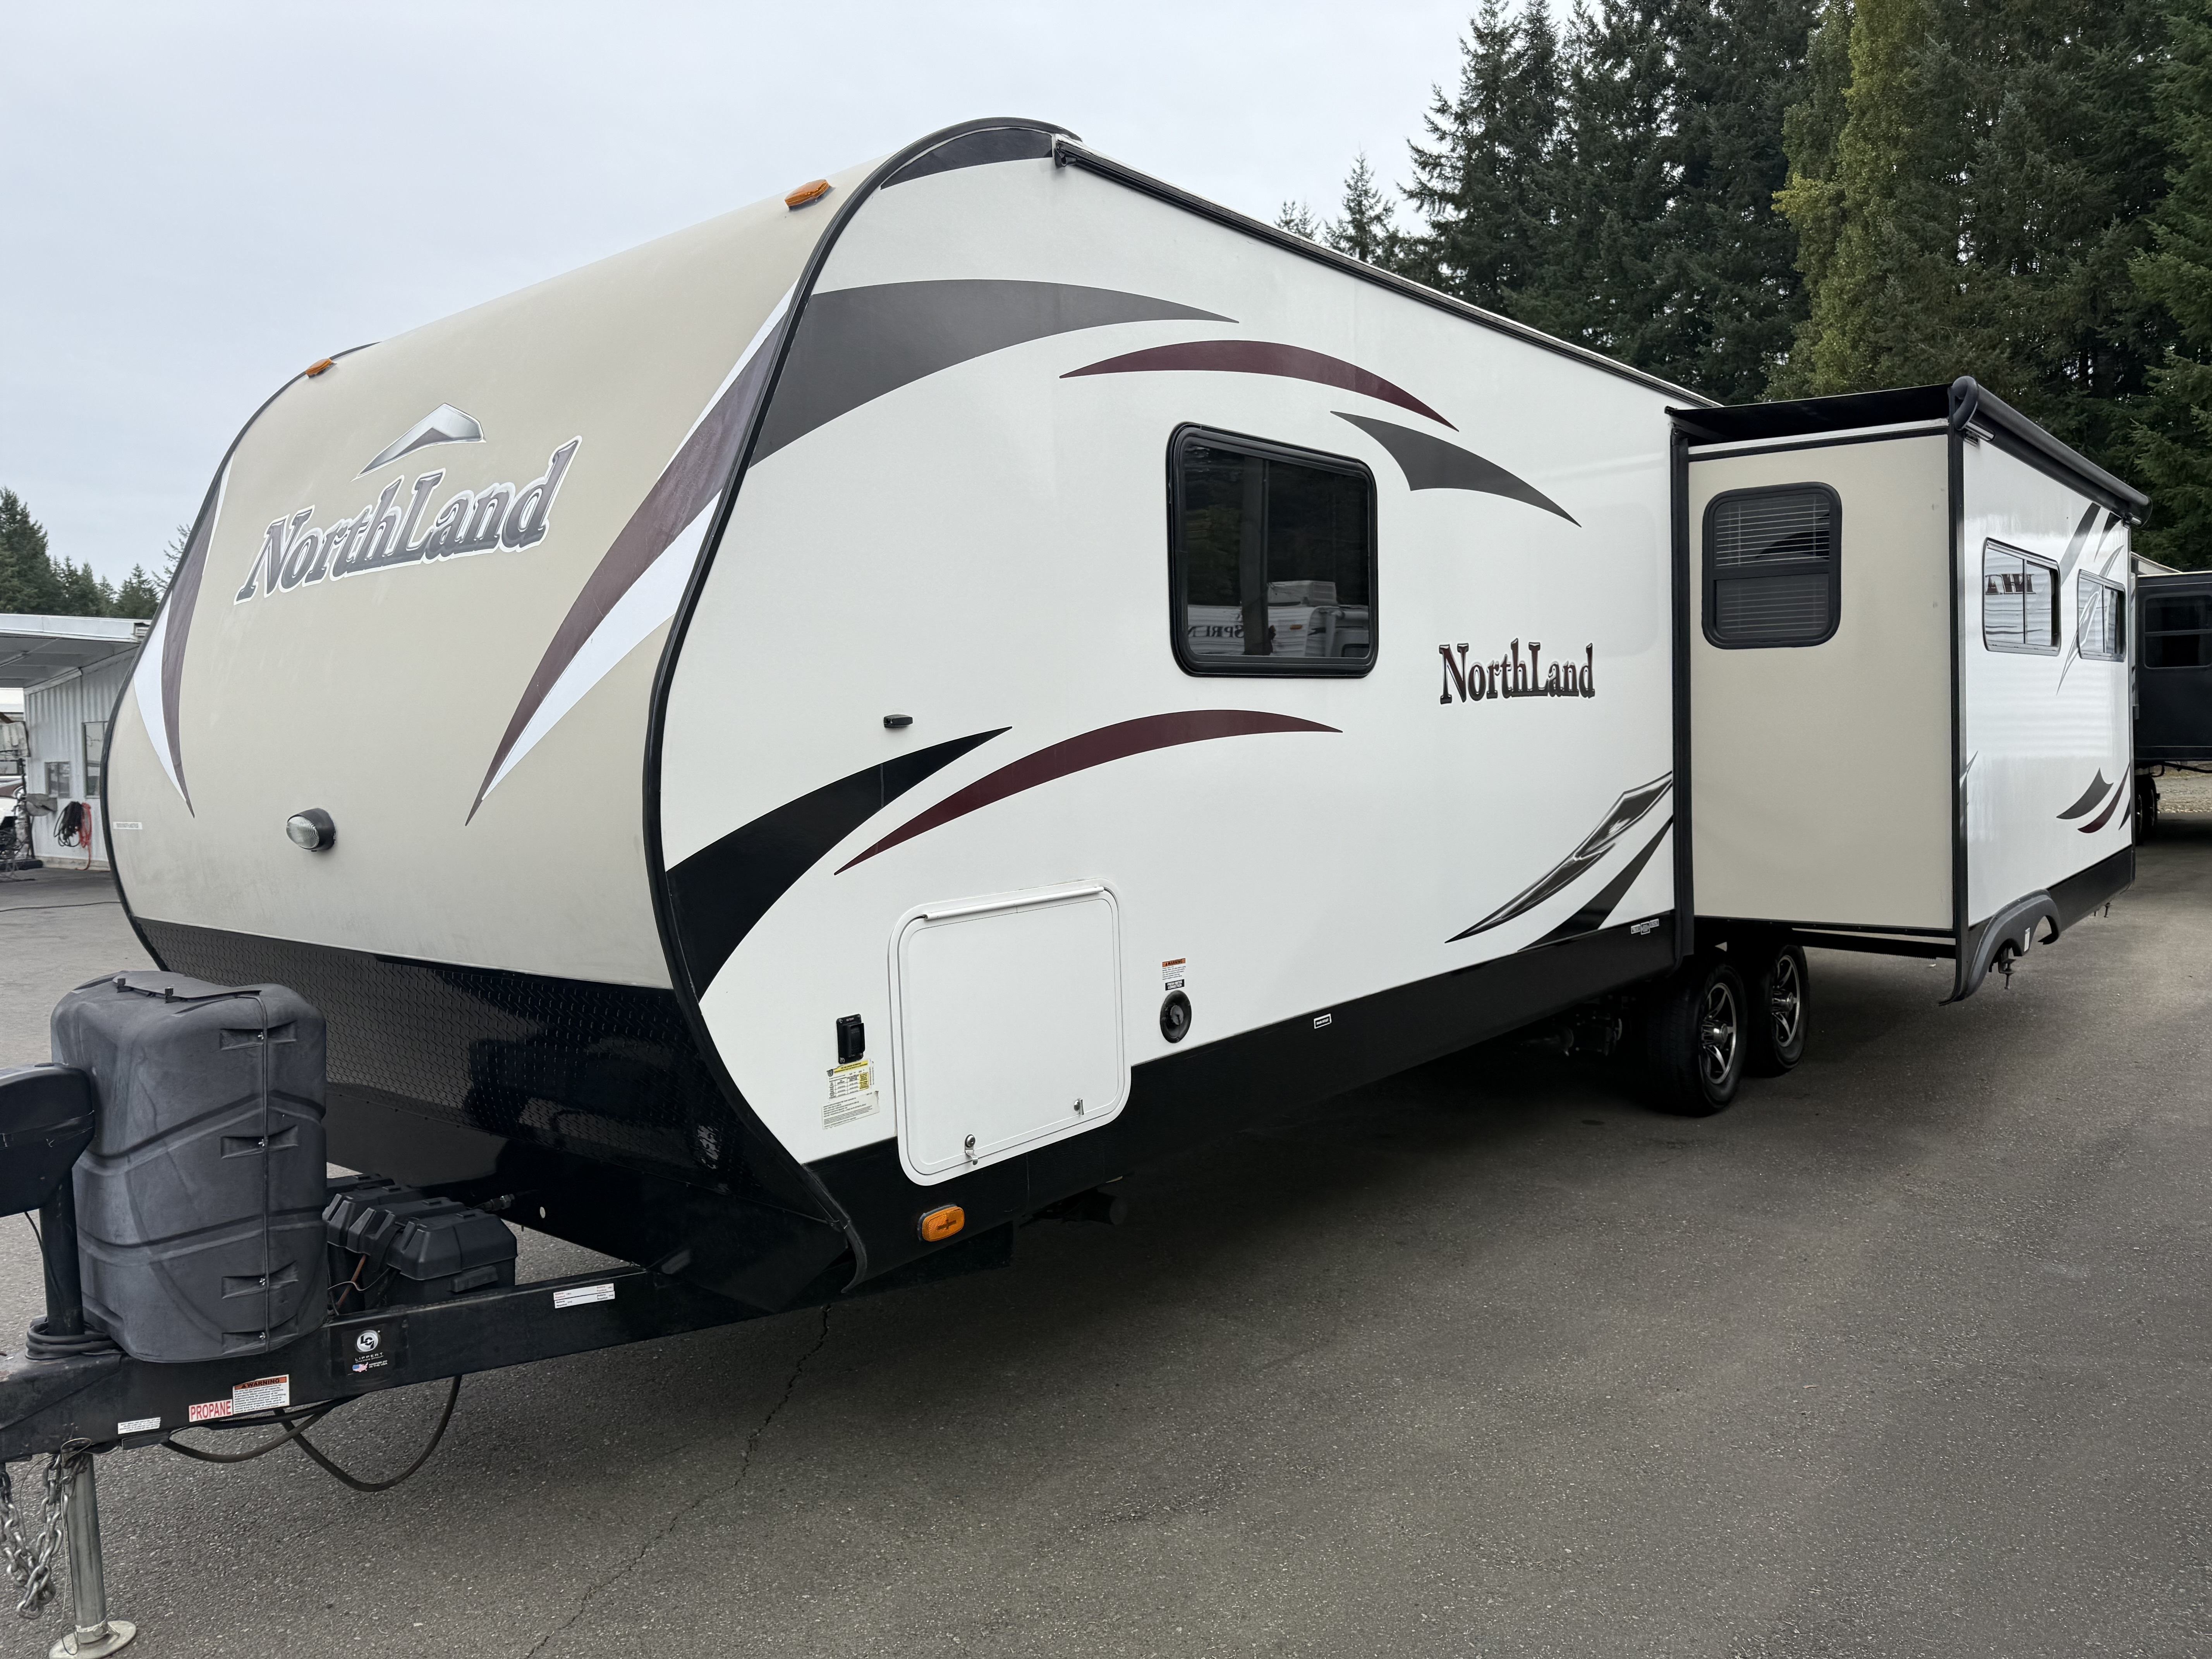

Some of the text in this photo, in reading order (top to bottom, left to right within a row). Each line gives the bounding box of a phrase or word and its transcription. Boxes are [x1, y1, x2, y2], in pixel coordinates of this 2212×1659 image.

[234, 435, 582, 605] NorthLand
[1439, 638, 1595, 705] NorthLand
[355, 1352, 383, 1361] LIPPERT
[247, 1379, 280, 1387] WARNING
[191, 1401, 231, 1420] PROPANE
